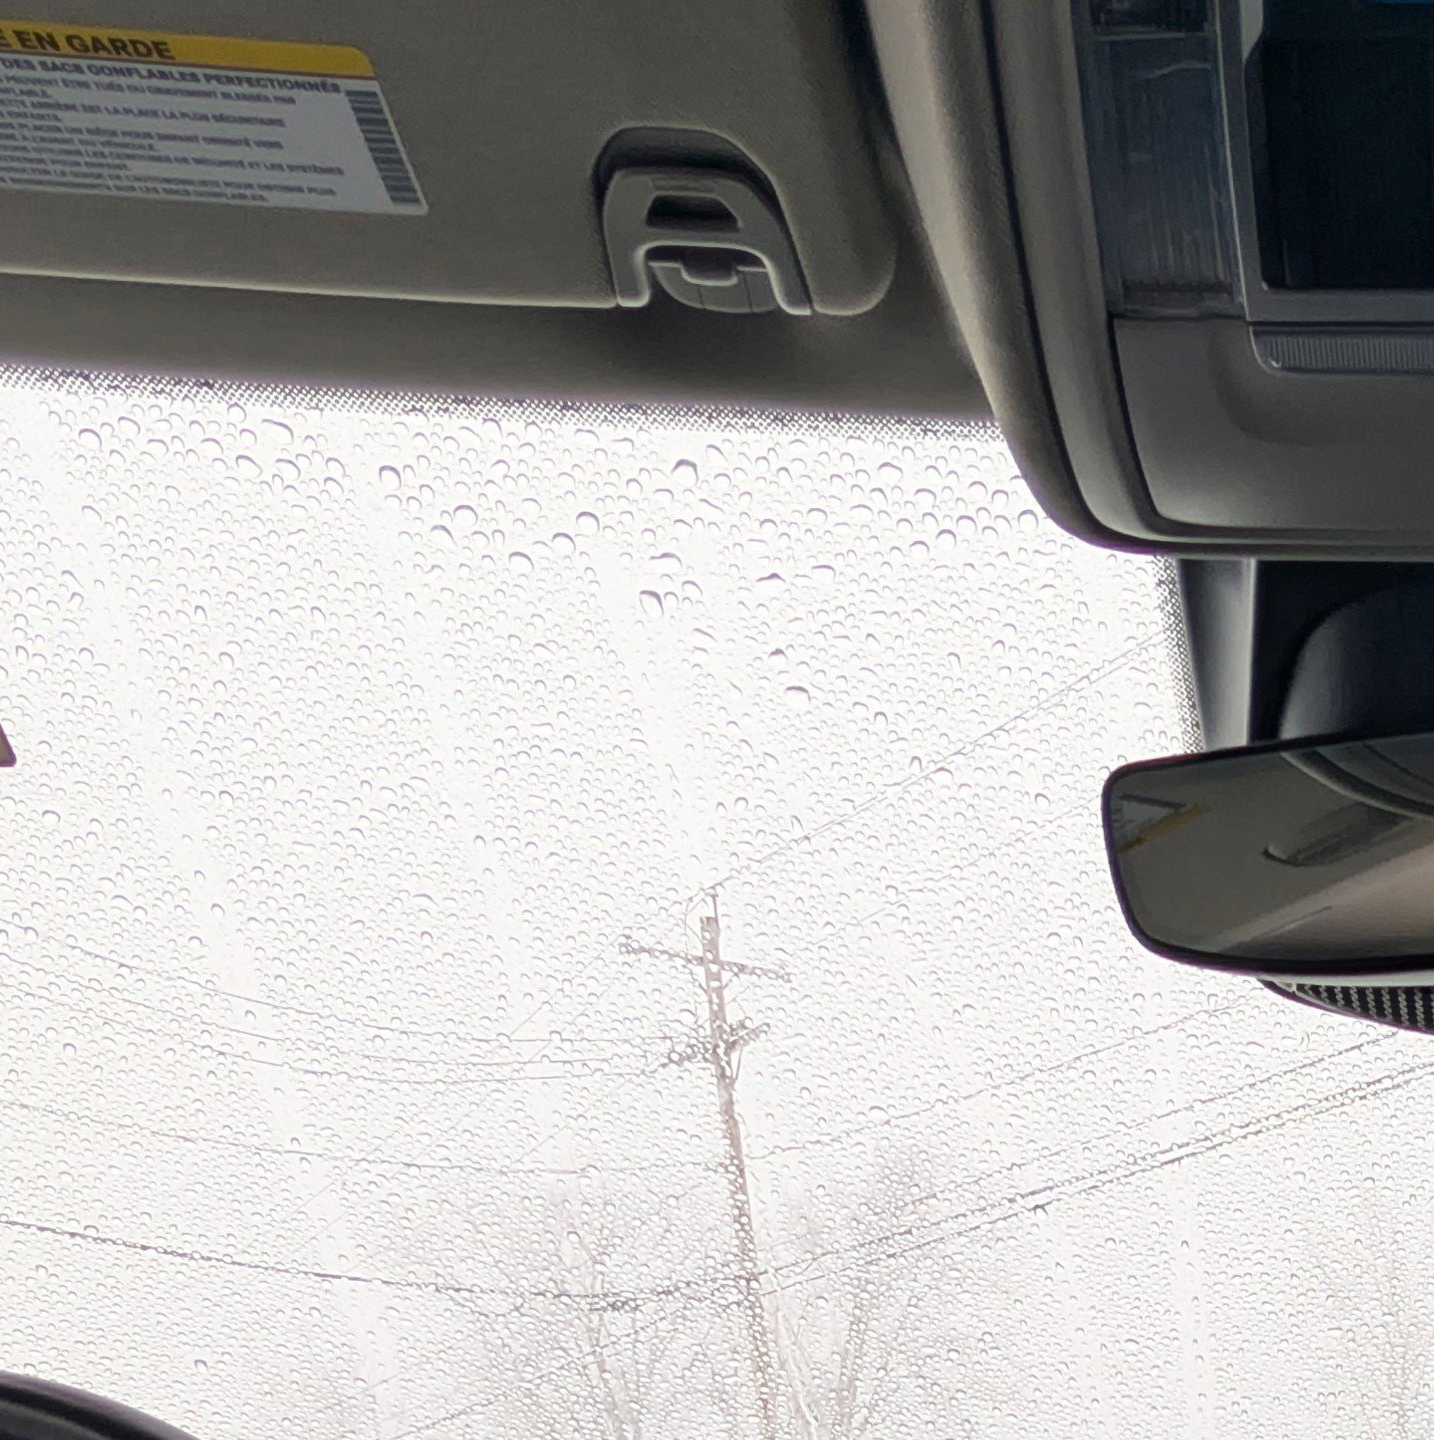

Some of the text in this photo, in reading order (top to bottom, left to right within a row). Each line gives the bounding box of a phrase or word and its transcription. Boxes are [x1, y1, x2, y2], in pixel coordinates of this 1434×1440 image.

[12, 30, 60, 52] EN
[65, 34, 176, 61] GARDE
[0, 57, 37, 71] DES
